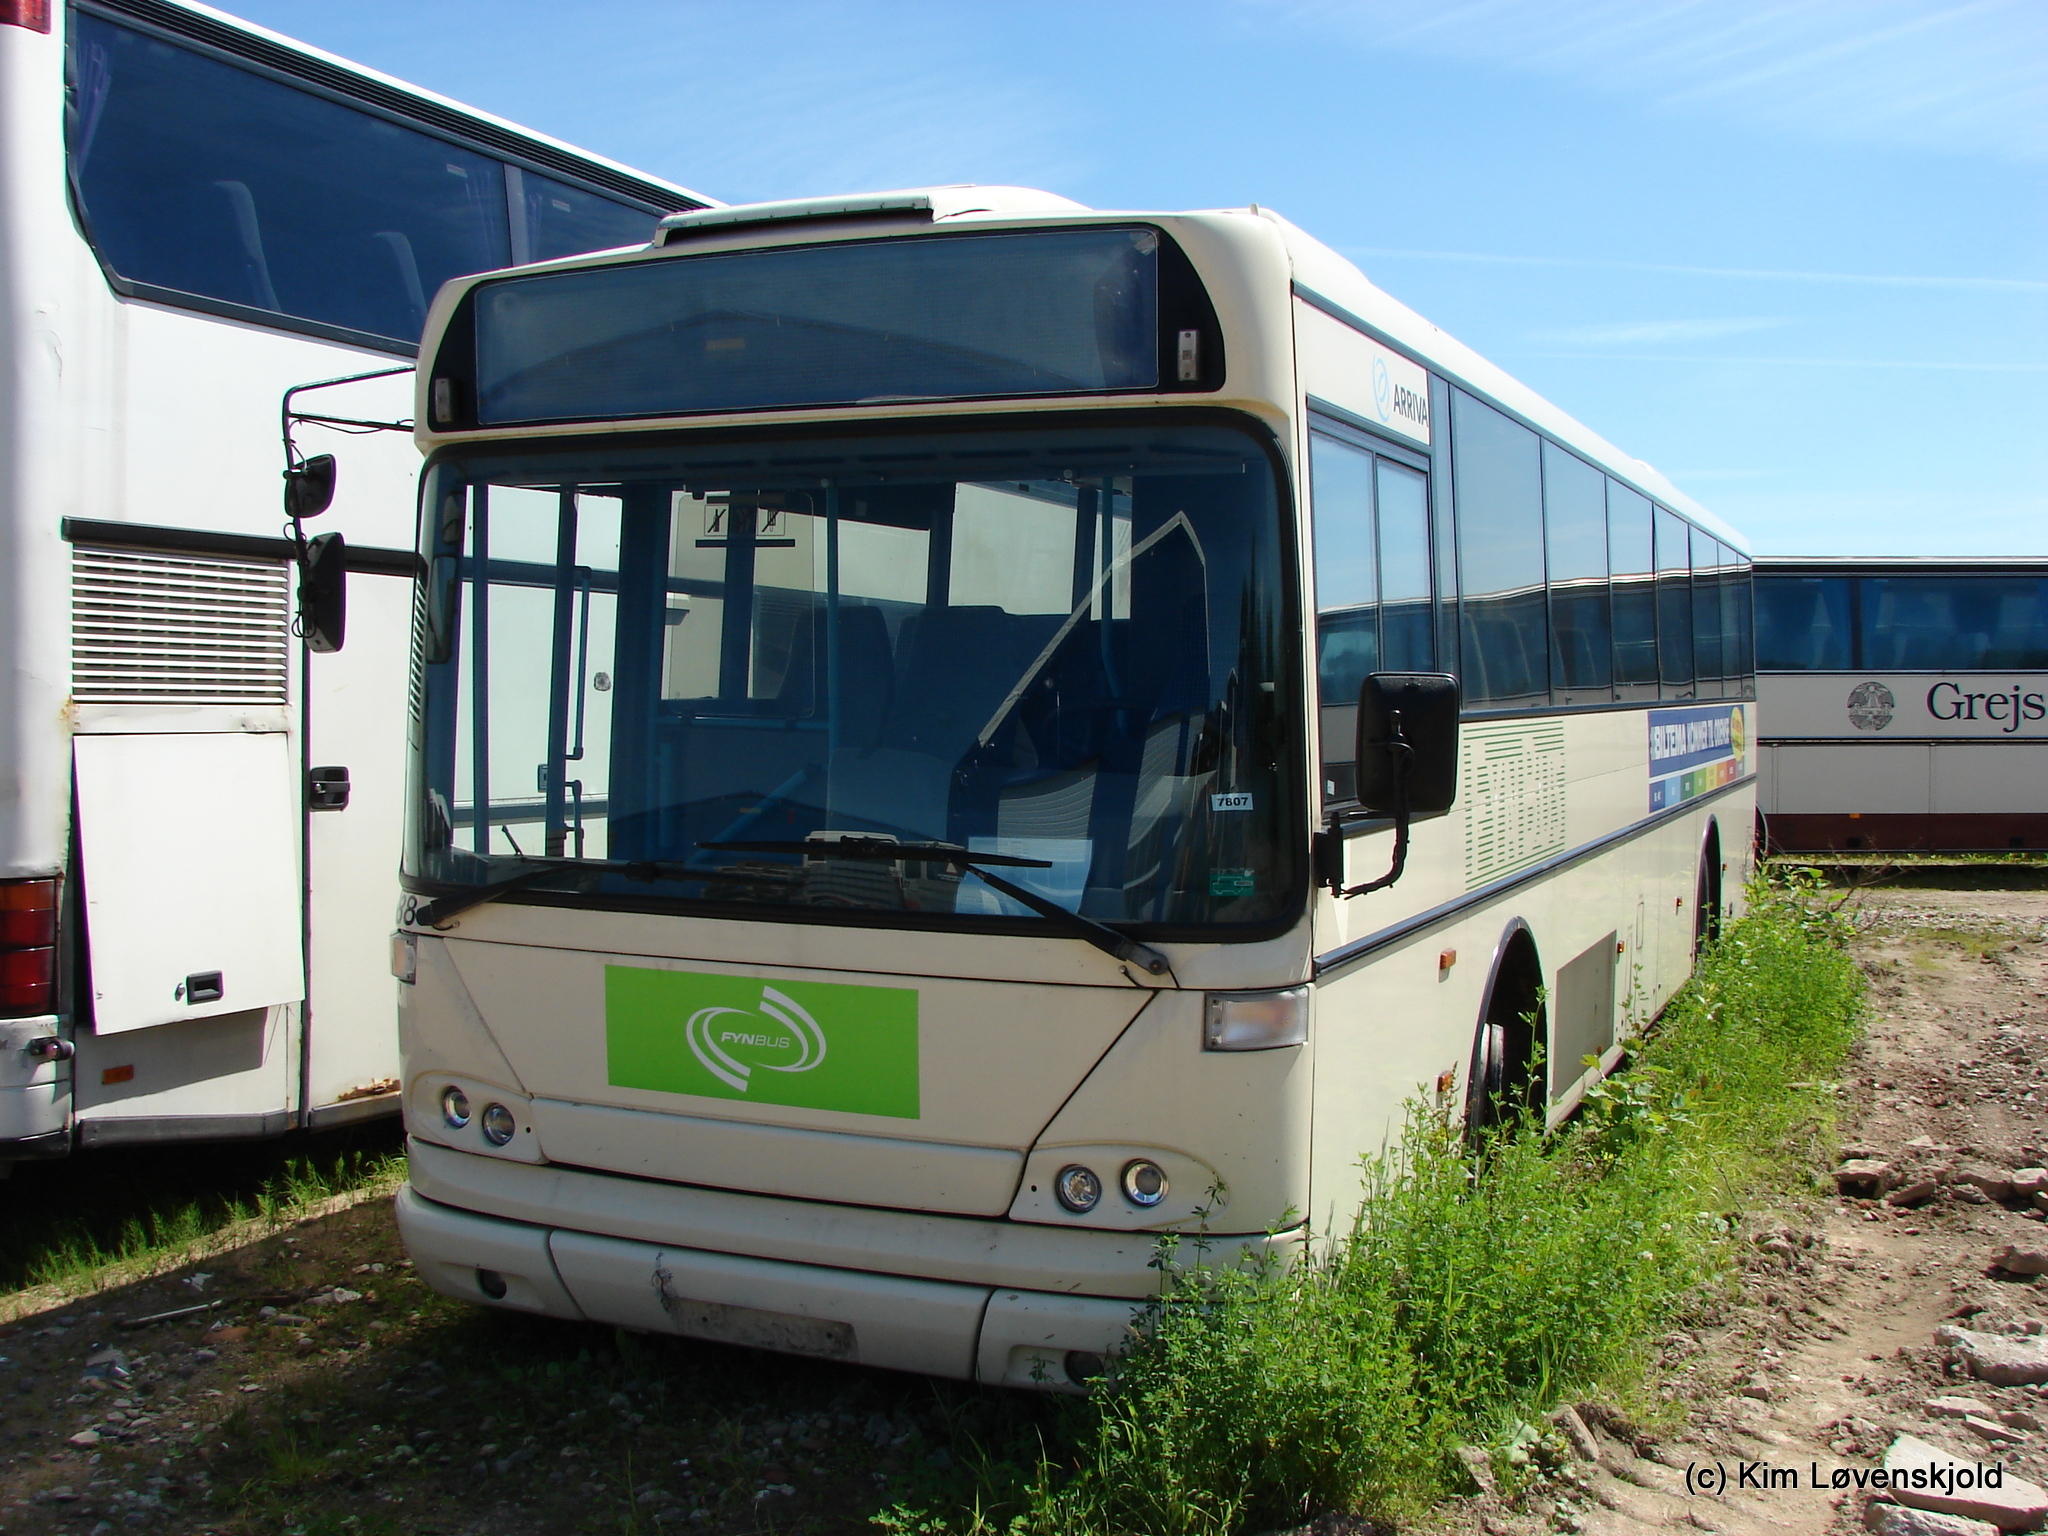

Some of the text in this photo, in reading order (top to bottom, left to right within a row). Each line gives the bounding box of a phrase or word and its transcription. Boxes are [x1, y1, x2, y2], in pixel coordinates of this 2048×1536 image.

[1393, 384, 1428, 427] ARRIVA
[1926, 682, 2046, 732] Grejs
[1217, 797, 1248, 807] 7807
[721, 1032, 790, 1048] FYNBUS
